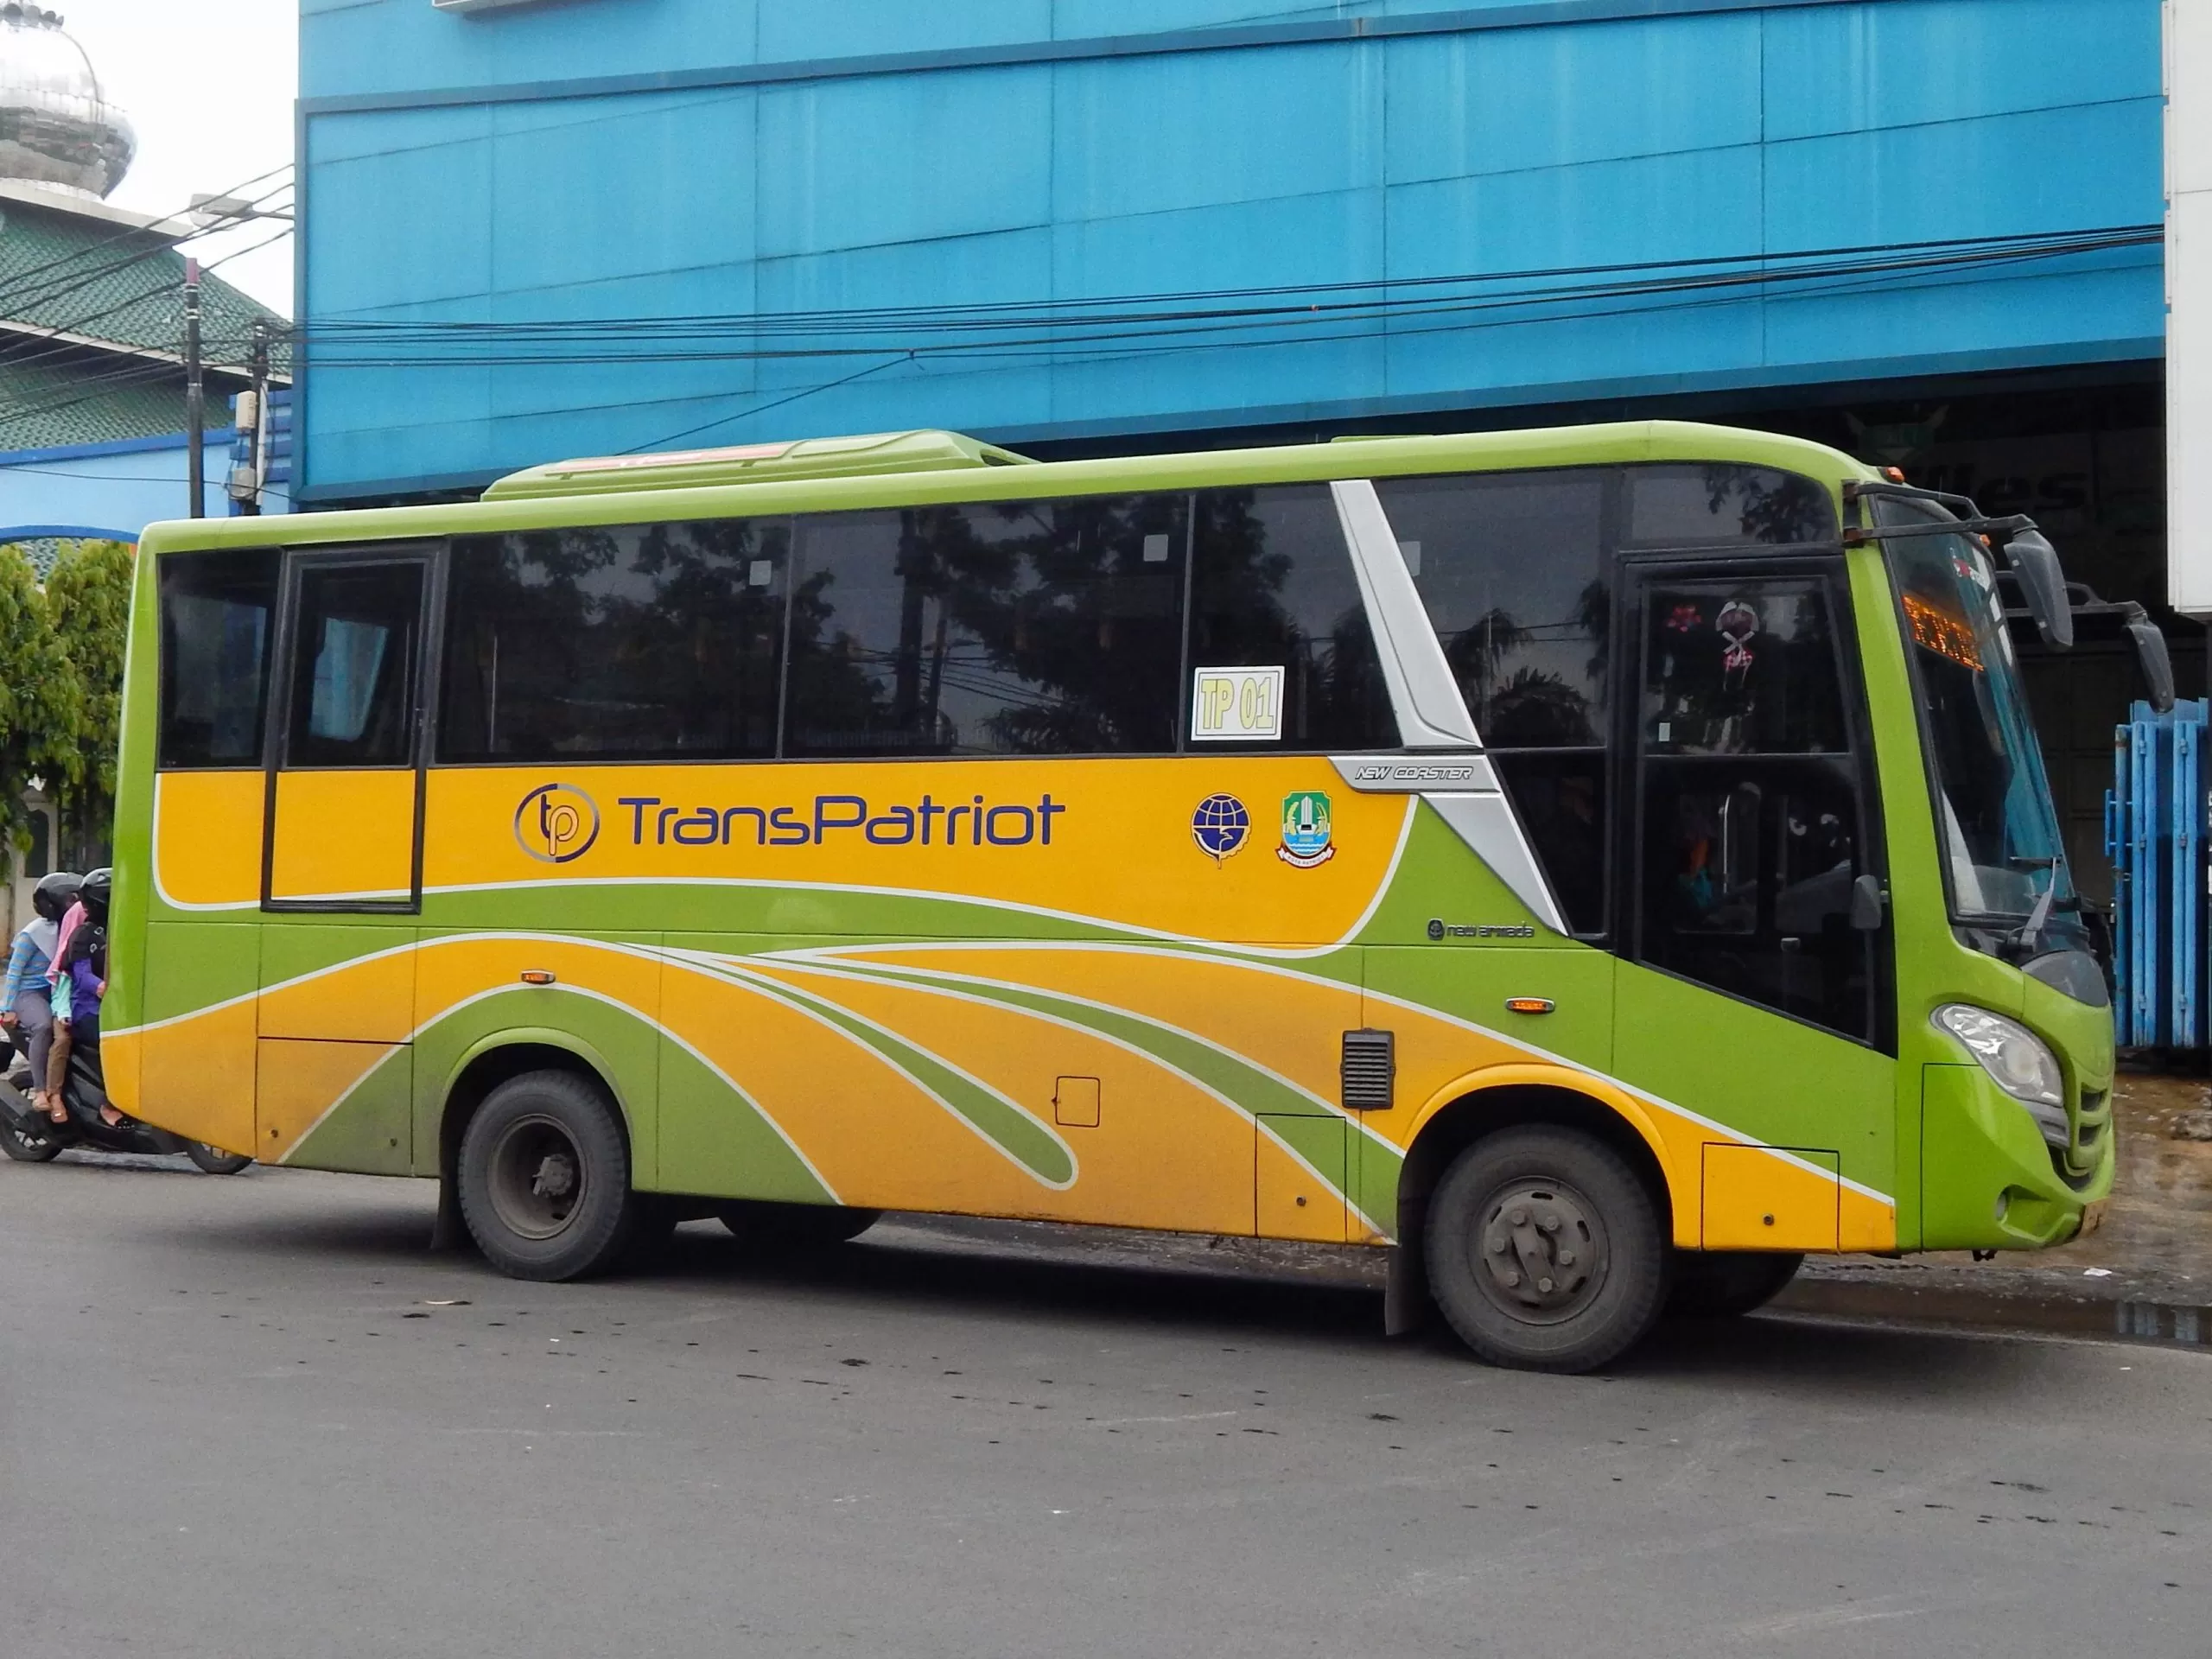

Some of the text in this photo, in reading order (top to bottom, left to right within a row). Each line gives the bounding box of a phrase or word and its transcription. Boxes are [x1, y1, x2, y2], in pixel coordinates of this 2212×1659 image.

[1201, 677, 1274, 729] TP 01
[1355, 766, 1473, 779] NEW COASTER
[618, 793, 1066, 846] TransPatriot
[1446, 921, 1535, 938] new armada
